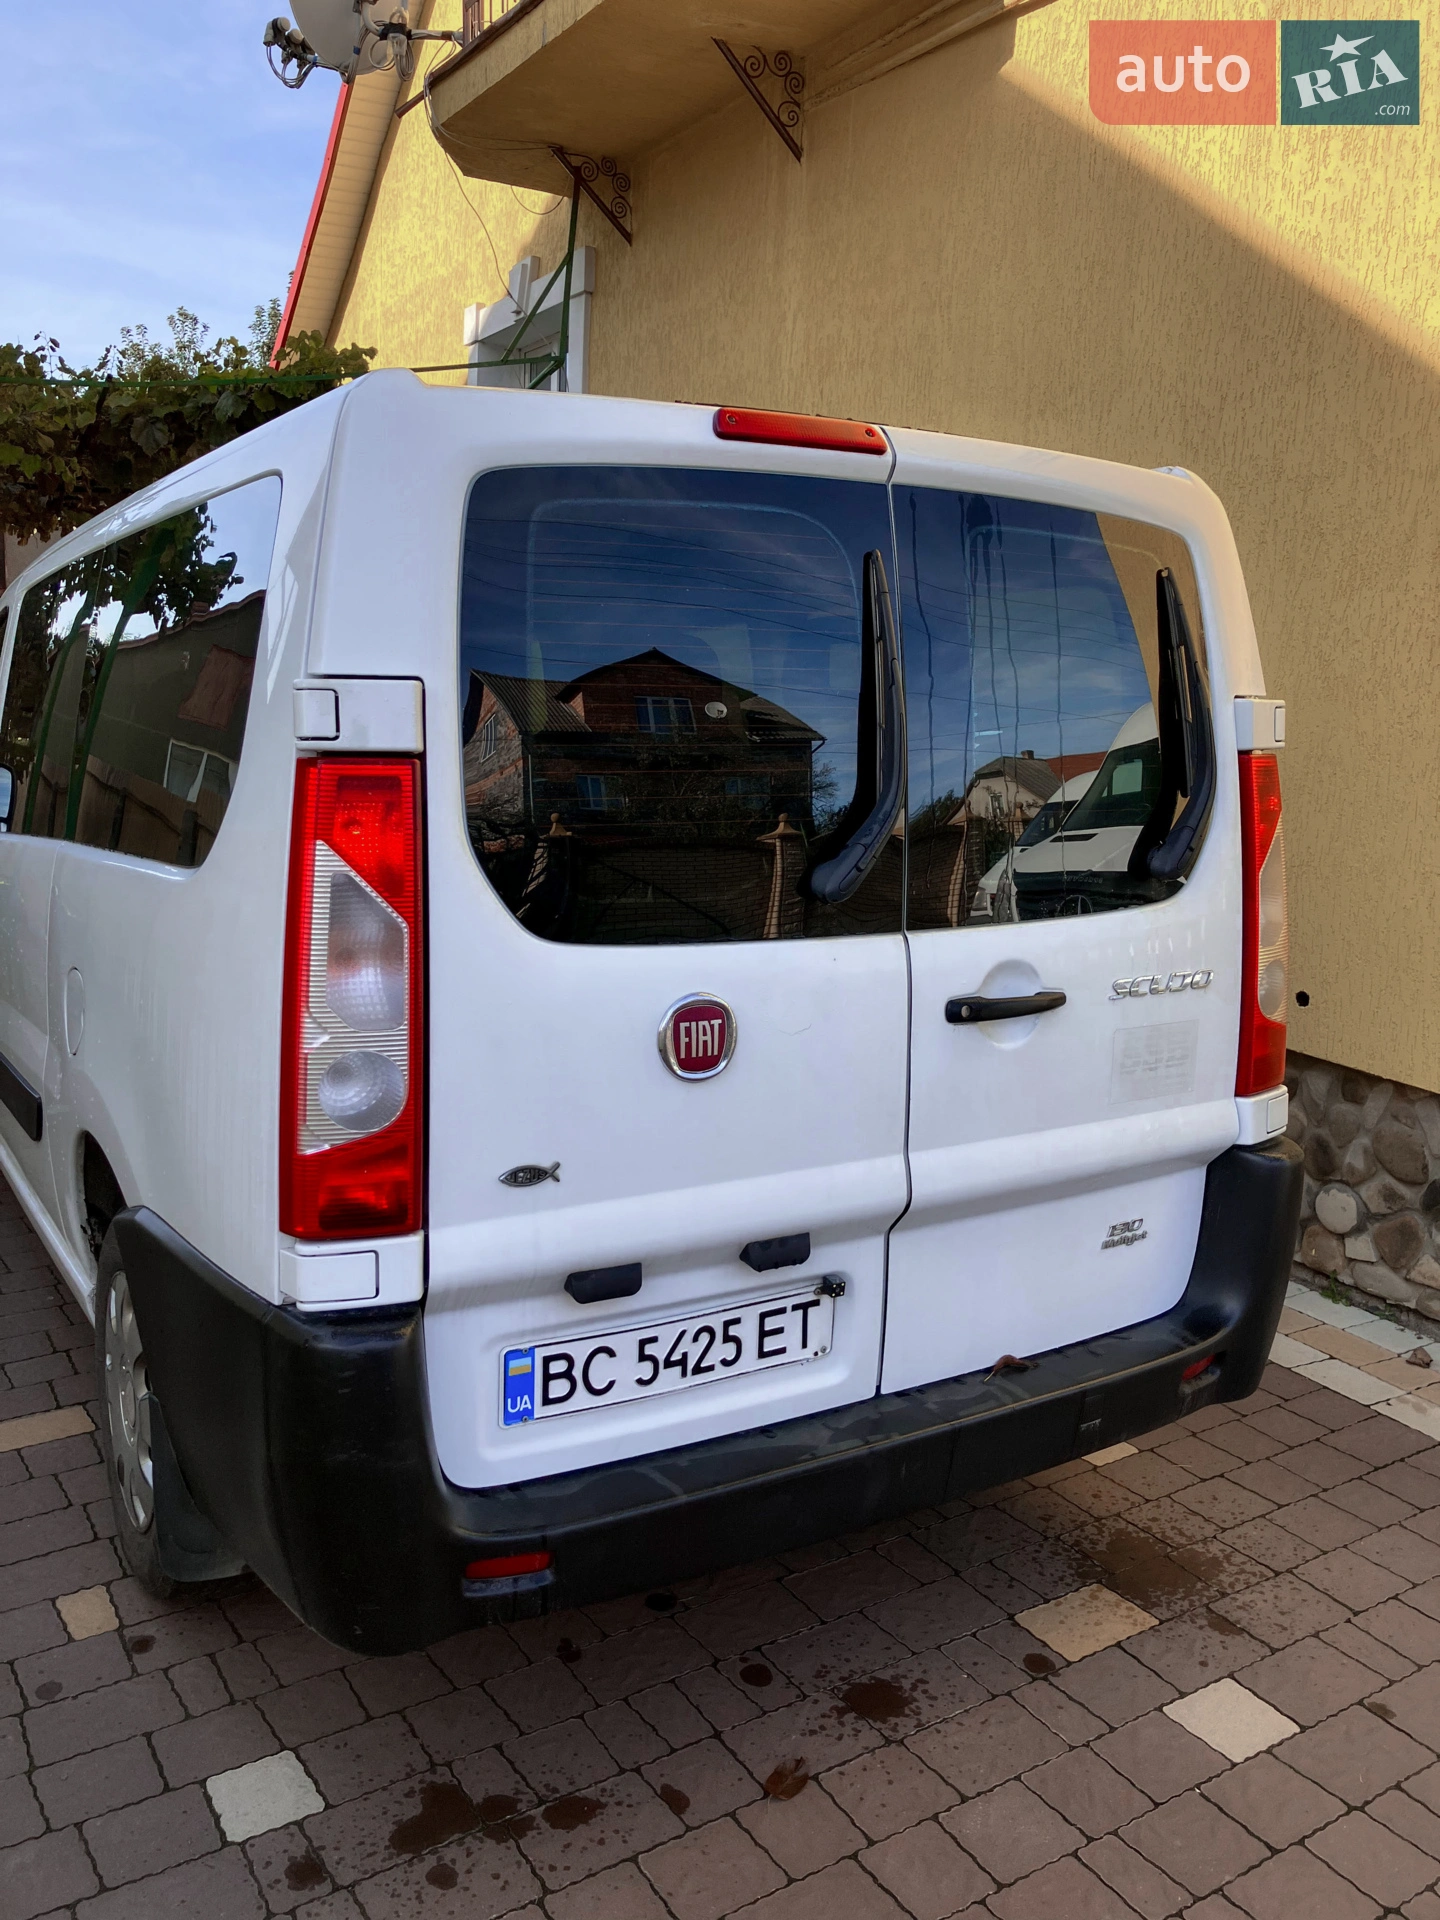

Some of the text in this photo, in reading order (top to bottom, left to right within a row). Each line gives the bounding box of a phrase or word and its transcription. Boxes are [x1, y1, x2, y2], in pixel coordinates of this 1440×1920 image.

[1109, 969, 1215, 1001] SCUDO
[678, 1019, 723, 1059] FIAT
[541, 1298, 821, 1407] BC 5425 ET
[507, 1398, 532, 1413] UA
